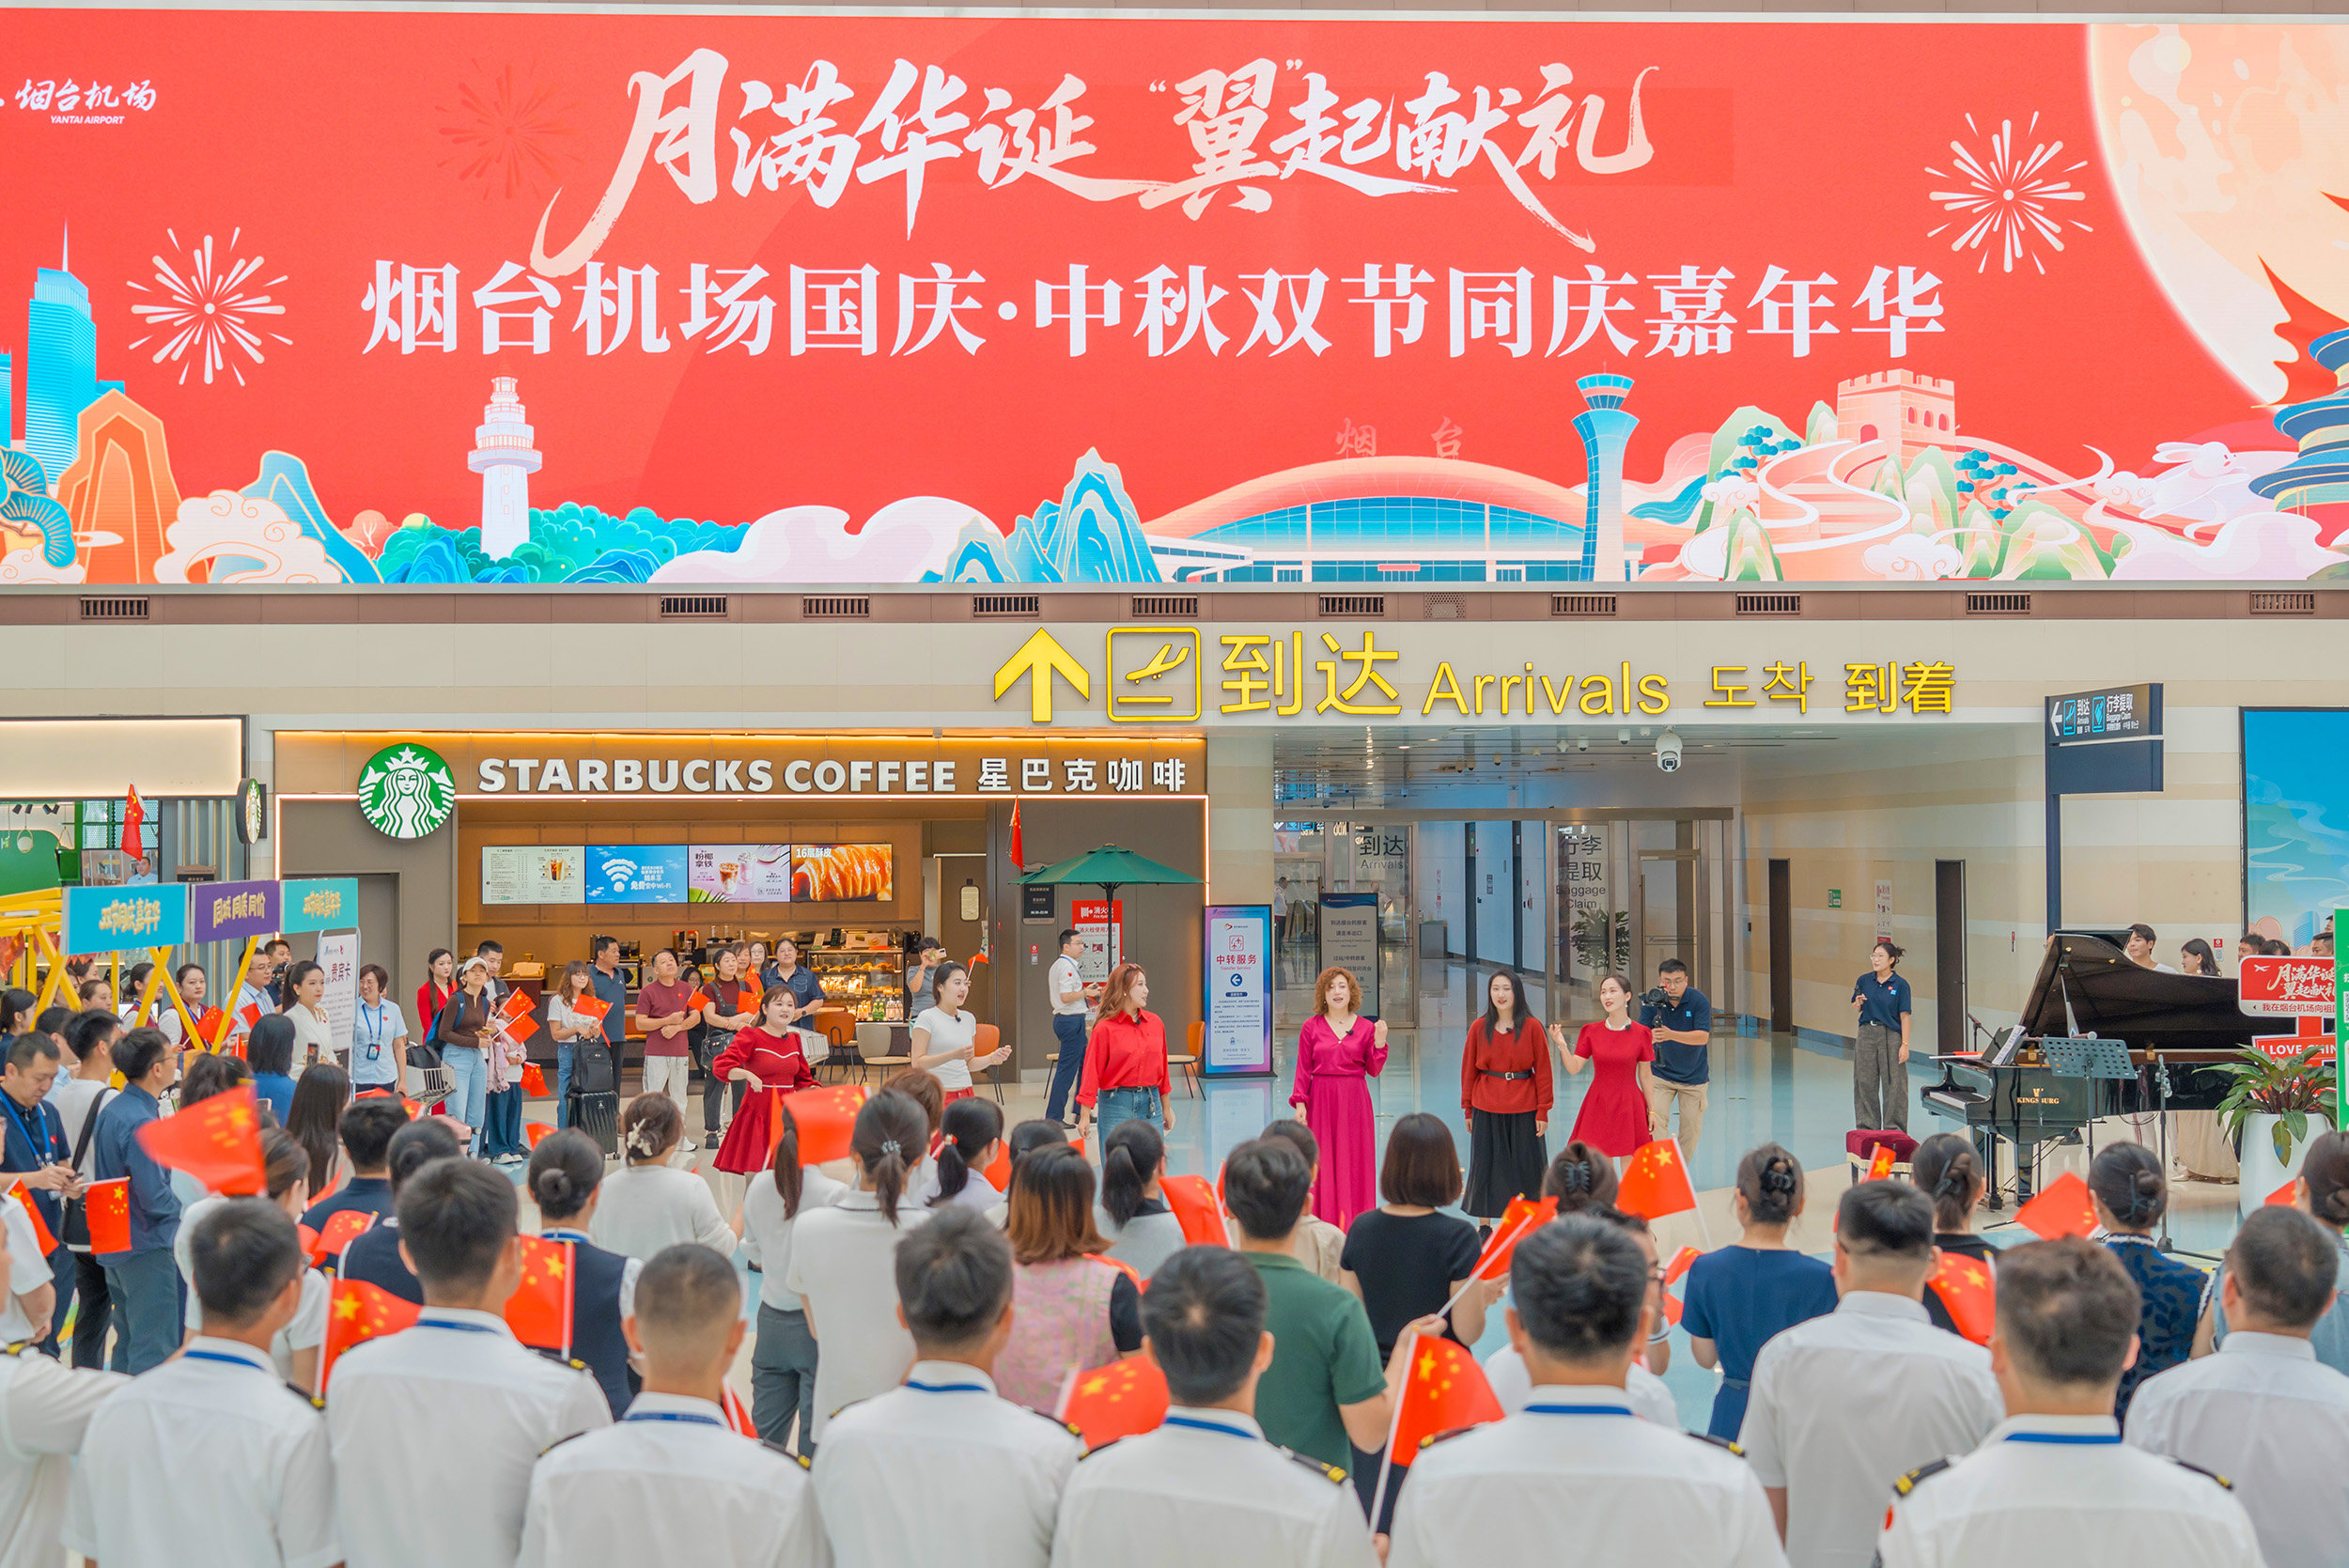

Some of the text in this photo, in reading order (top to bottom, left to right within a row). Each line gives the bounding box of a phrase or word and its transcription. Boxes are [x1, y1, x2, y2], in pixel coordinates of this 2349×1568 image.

[15, 78, 156, 112] 烟台机场
[51, 116, 125, 124] YANTAI AIRPORT
[361, 260, 1947, 360] 烟台机场国庆·中秋双节同庆嘉年华
[1335, 416, 1463, 458] 烟台
[1220, 630, 1956, 716] 到达 Arrivals 도착 到着
[2077, 698, 2091, 716] 到达
[2107, 693, 2134, 713] 行李提取
[478, 757, 1186, 793] STARBUCKS COFFEE 星巴克咖啡
[1360, 835, 1404, 856] 到达
[1361, 860, 1404, 870] Arrivals
[1556, 885, 1606, 896] Baggage
[1565, 899, 1597, 908] Claim
[1216, 954, 1257, 965] 中转服务
[2263, 1002, 2335, 1013] 我在烟台机场向祖
[2269, 1045, 2302, 1054] LOVE
